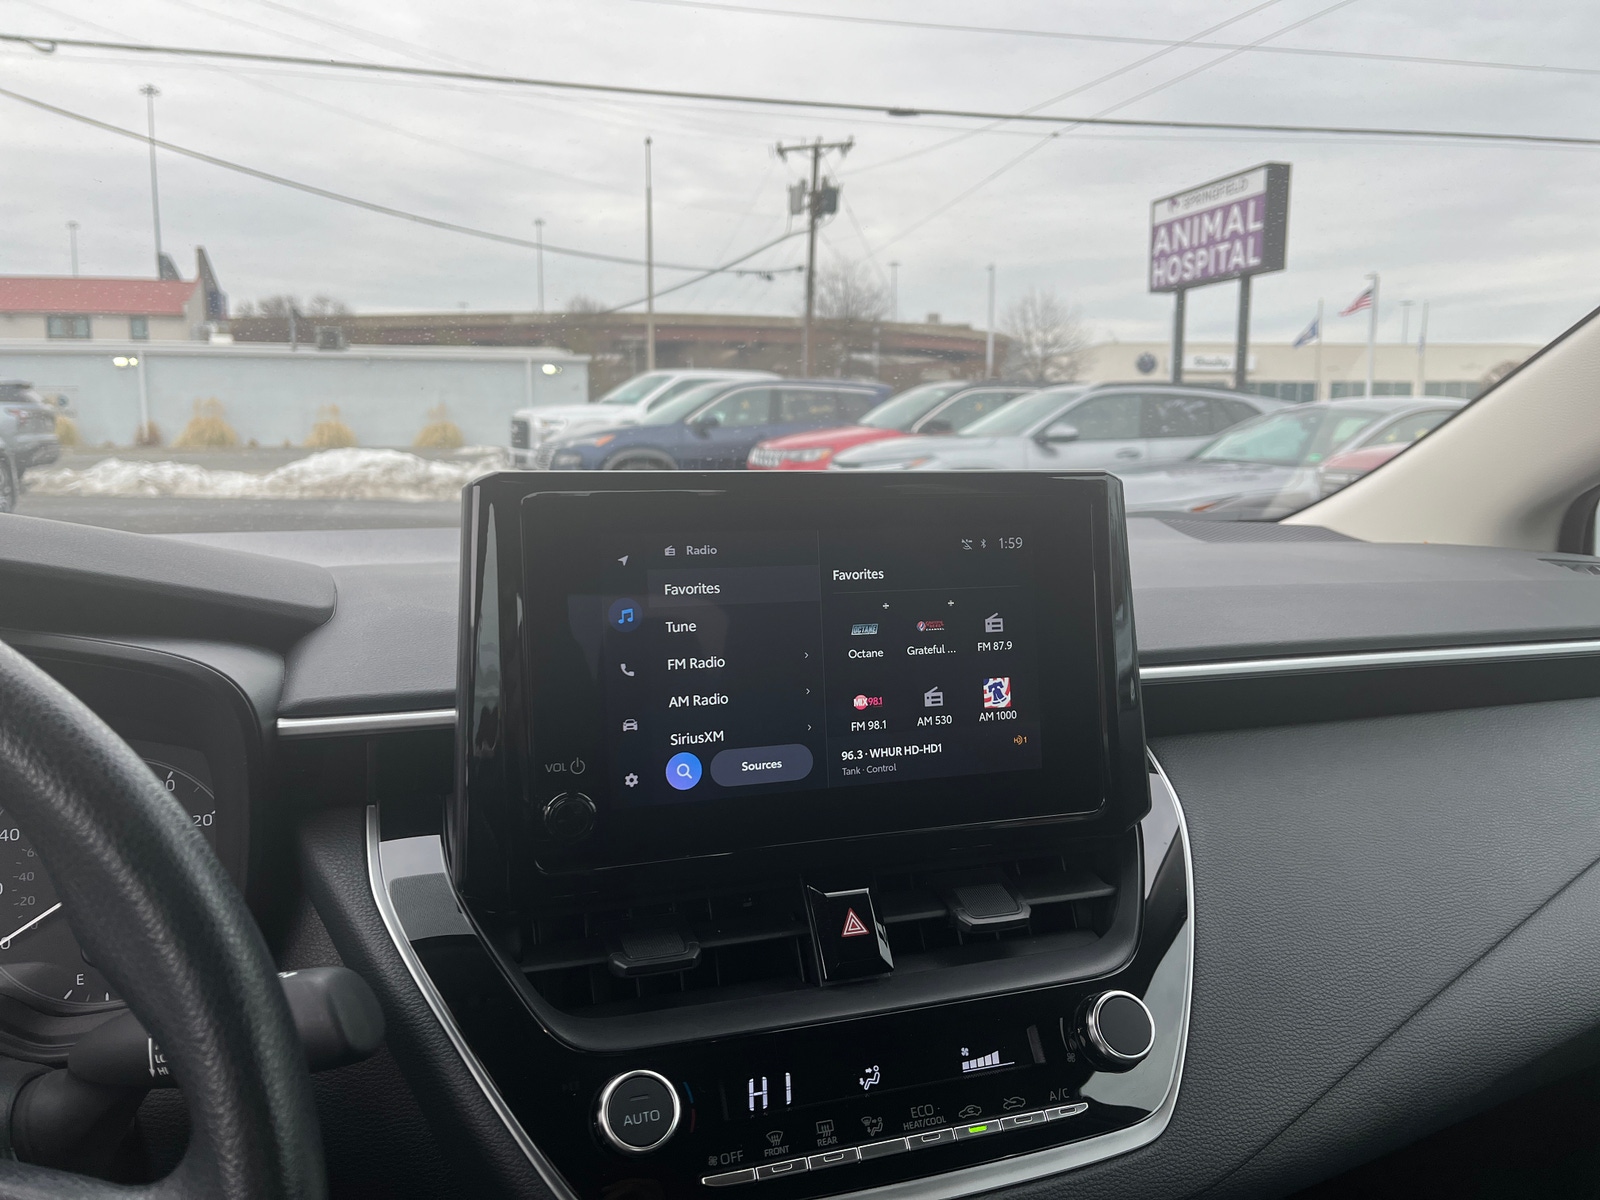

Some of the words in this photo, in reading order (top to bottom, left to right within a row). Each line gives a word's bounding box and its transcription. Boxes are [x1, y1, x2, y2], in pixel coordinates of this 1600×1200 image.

[1153, 199, 1263, 257] ANIMAL
[1151, 236, 1261, 288] HOSPITAL
[998, 537, 1023, 549] 1:59
[686, 544, 717, 556] Radio
[832, 568, 885, 581] Favorites
[664, 582, 721, 595] Favorites
[665, 621, 697, 633] Tune
[906, 644, 945, 655] Grateful
[977, 641, 991, 651] FM
[993, 640, 1013, 651] 87.9
[848, 647, 884, 658] Octane
[667, 658, 686, 670] FM
[689, 656, 726, 669] Radio
[668, 695, 690, 708] AM
[693, 693, 729, 706] Radio
[916, 716, 934, 727] AM
[935, 714, 953, 726] 530
[978, 711, 995, 722] AM
[996, 709, 1018, 721] 1000
[851, 721, 866, 732] FM
[867, 719, 887, 731] 98.1
[670, 730, 725, 745] SiriusXM
[841, 750, 863, 761] 96.3
[869, 746, 902, 758] WHUR
[904, 743, 943, 756] HD-HD1
[545, 762, 567, 773] VOL
[741, 760, 783, 772] Sources
[842, 766, 861, 776] Tank
[866, 763, 897, 774] Control
[20, 896, 36, 906] 20
[76, 973, 85, 986] E
[1050, 1087, 1070, 1102] A/C
[623, 1109, 661, 1127] AUTO
[910, 1104, 935, 1119] ECO
[903, 1115, 947, 1131] HEAT/COOL
[817, 1136, 839, 1147] REAR
[720, 1150, 744, 1165] OFF
[764, 1145, 790, 1157] FRONT
